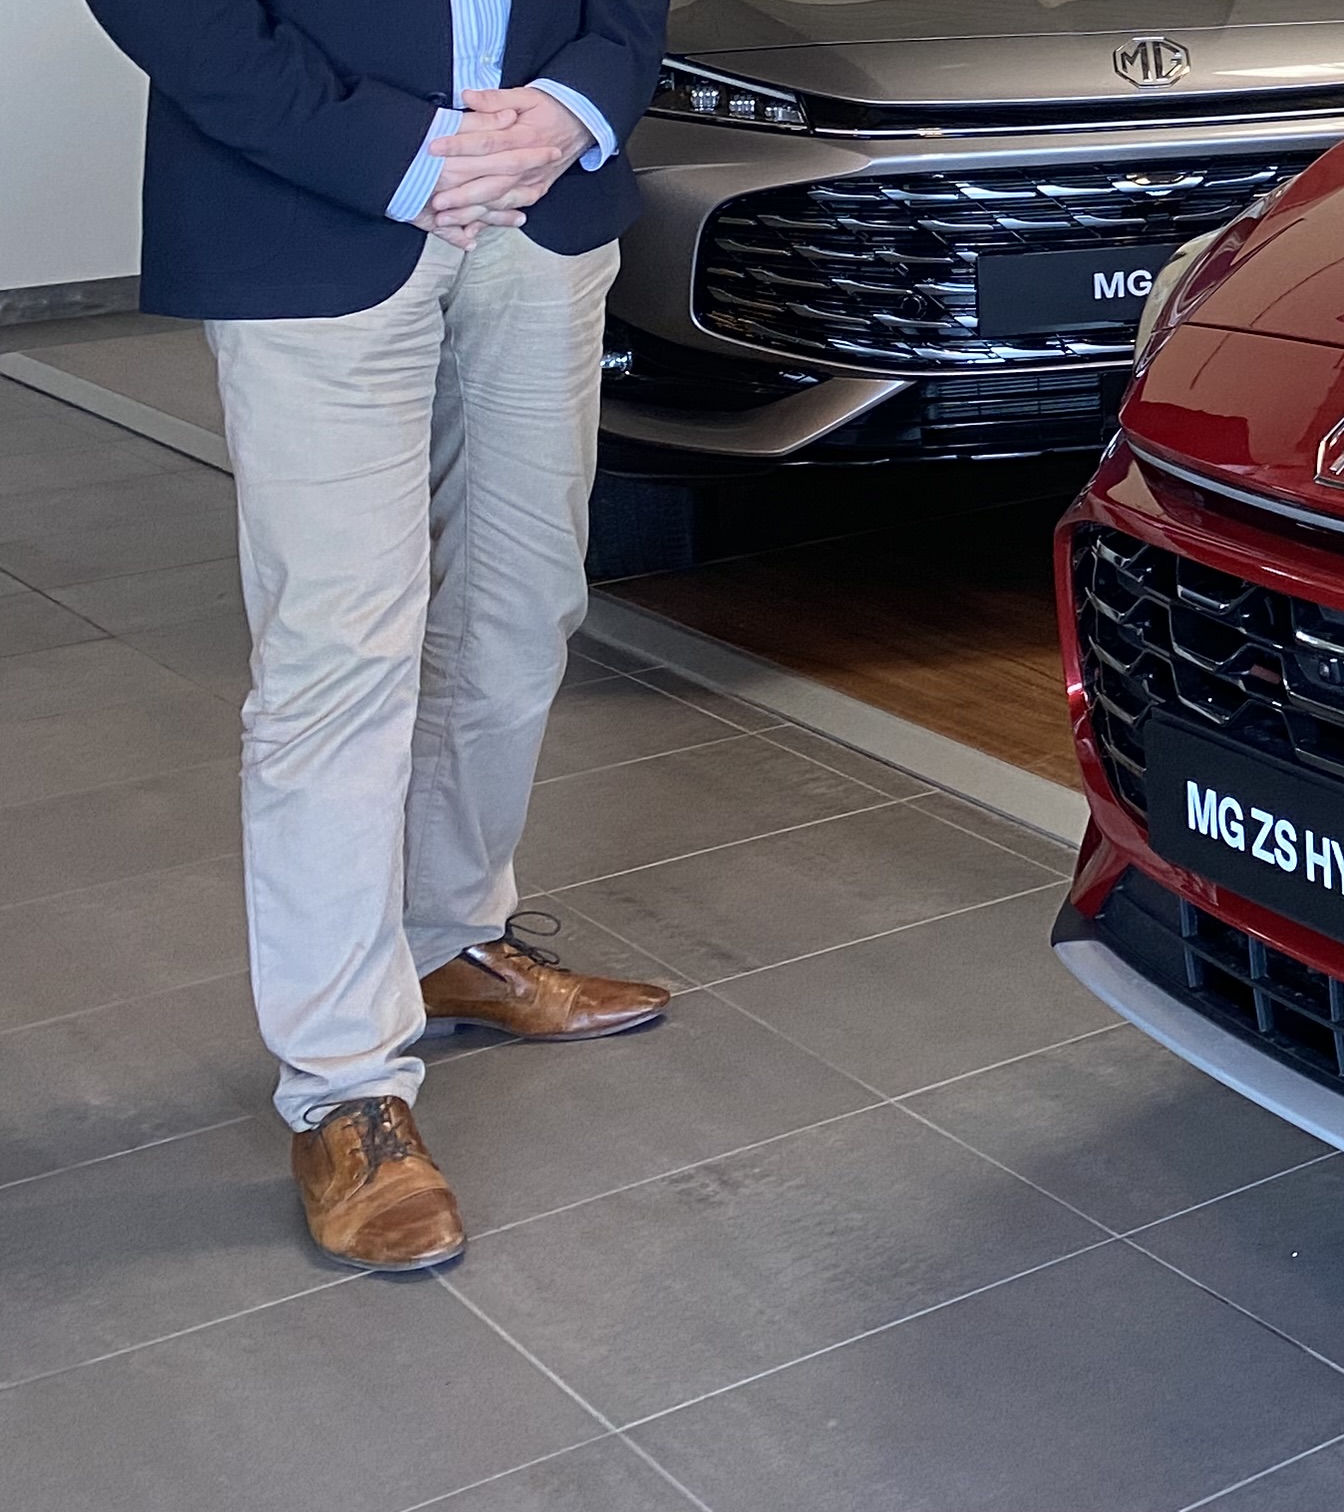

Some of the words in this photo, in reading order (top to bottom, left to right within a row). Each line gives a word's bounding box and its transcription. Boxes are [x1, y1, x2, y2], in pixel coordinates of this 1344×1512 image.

[1118, 39, 1185, 83] MG
[1093, 268, 1153, 300] MG
[1187, 780, 1246, 852] MG
[1250, 806, 1299, 873] ZS
